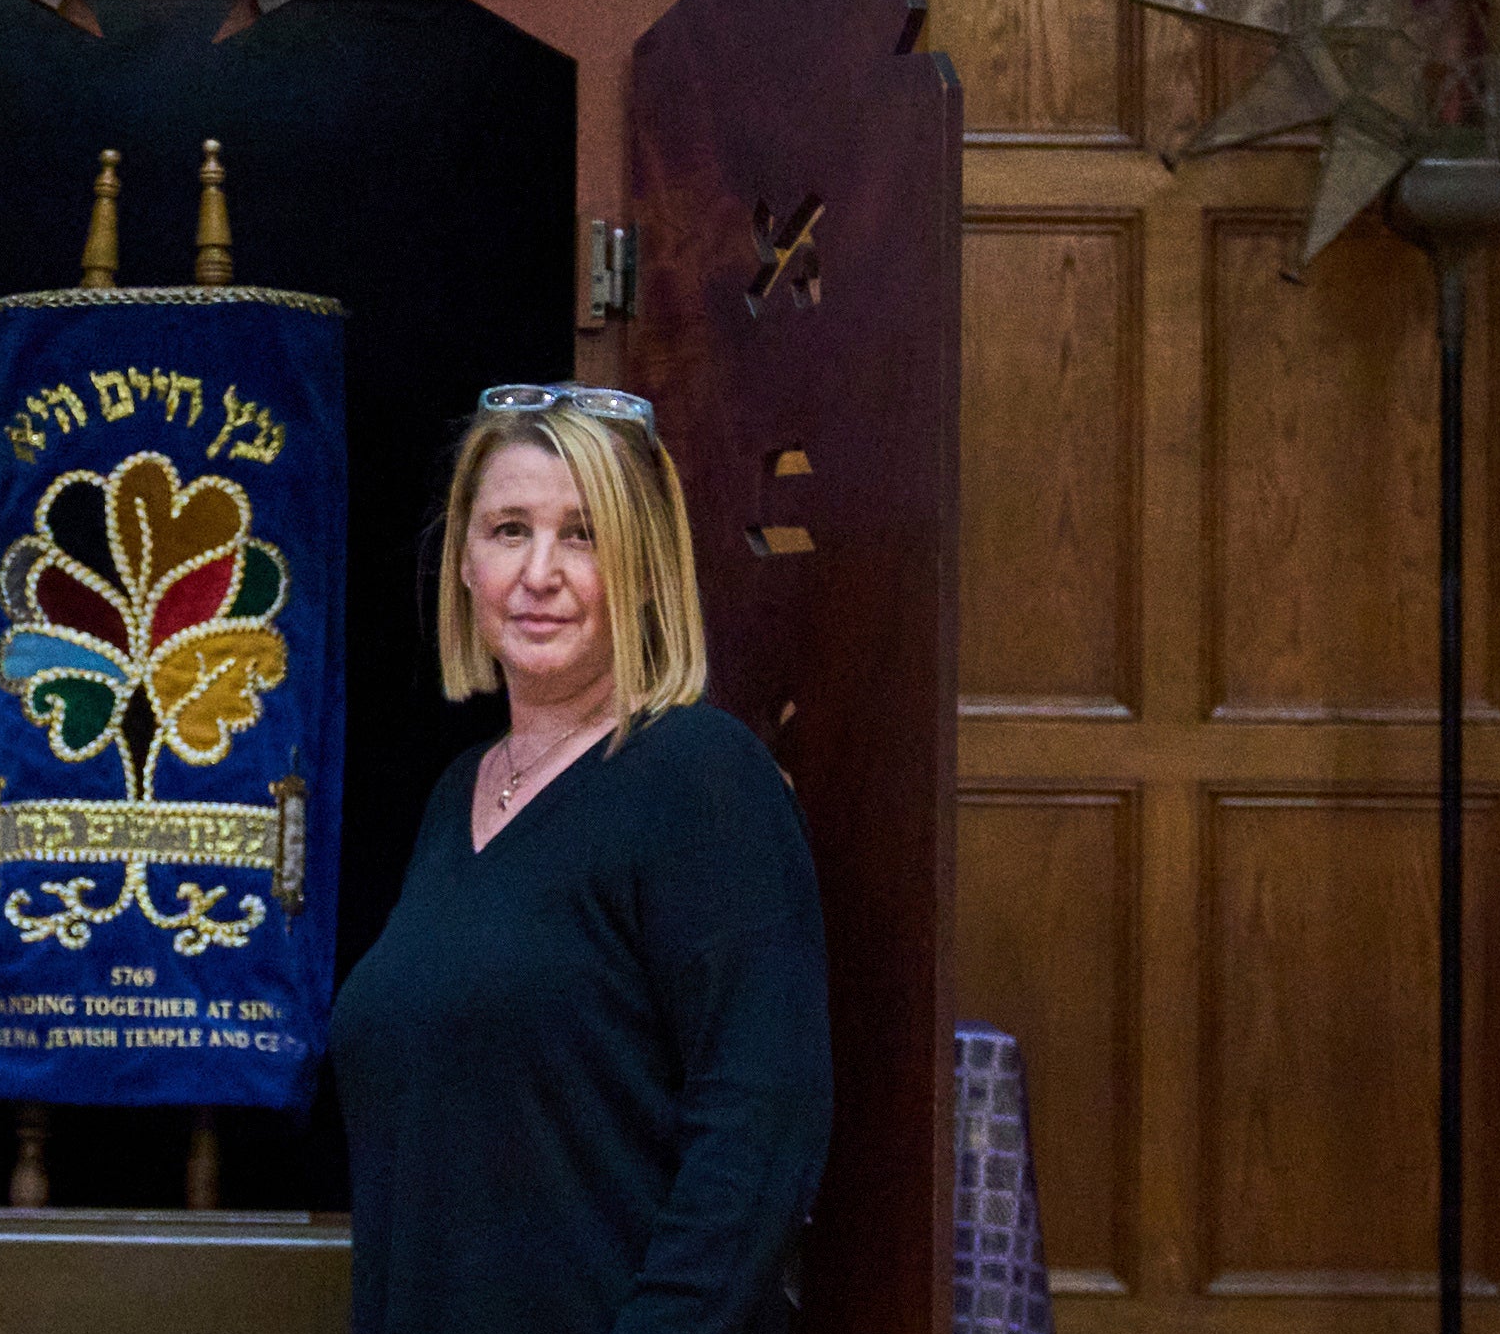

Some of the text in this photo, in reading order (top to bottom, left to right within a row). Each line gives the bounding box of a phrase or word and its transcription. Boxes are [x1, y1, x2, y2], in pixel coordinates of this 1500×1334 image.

[3, 366, 287, 465] עץ חיים היא
[82, 995, 198, 1018] TOGETHER
[206, 999, 233, 1019] AT
[45, 1027, 118, 1050] JEWISH
[122, 1027, 203, 1049] TEMPLE
[208, 1029, 250, 1049] AND
